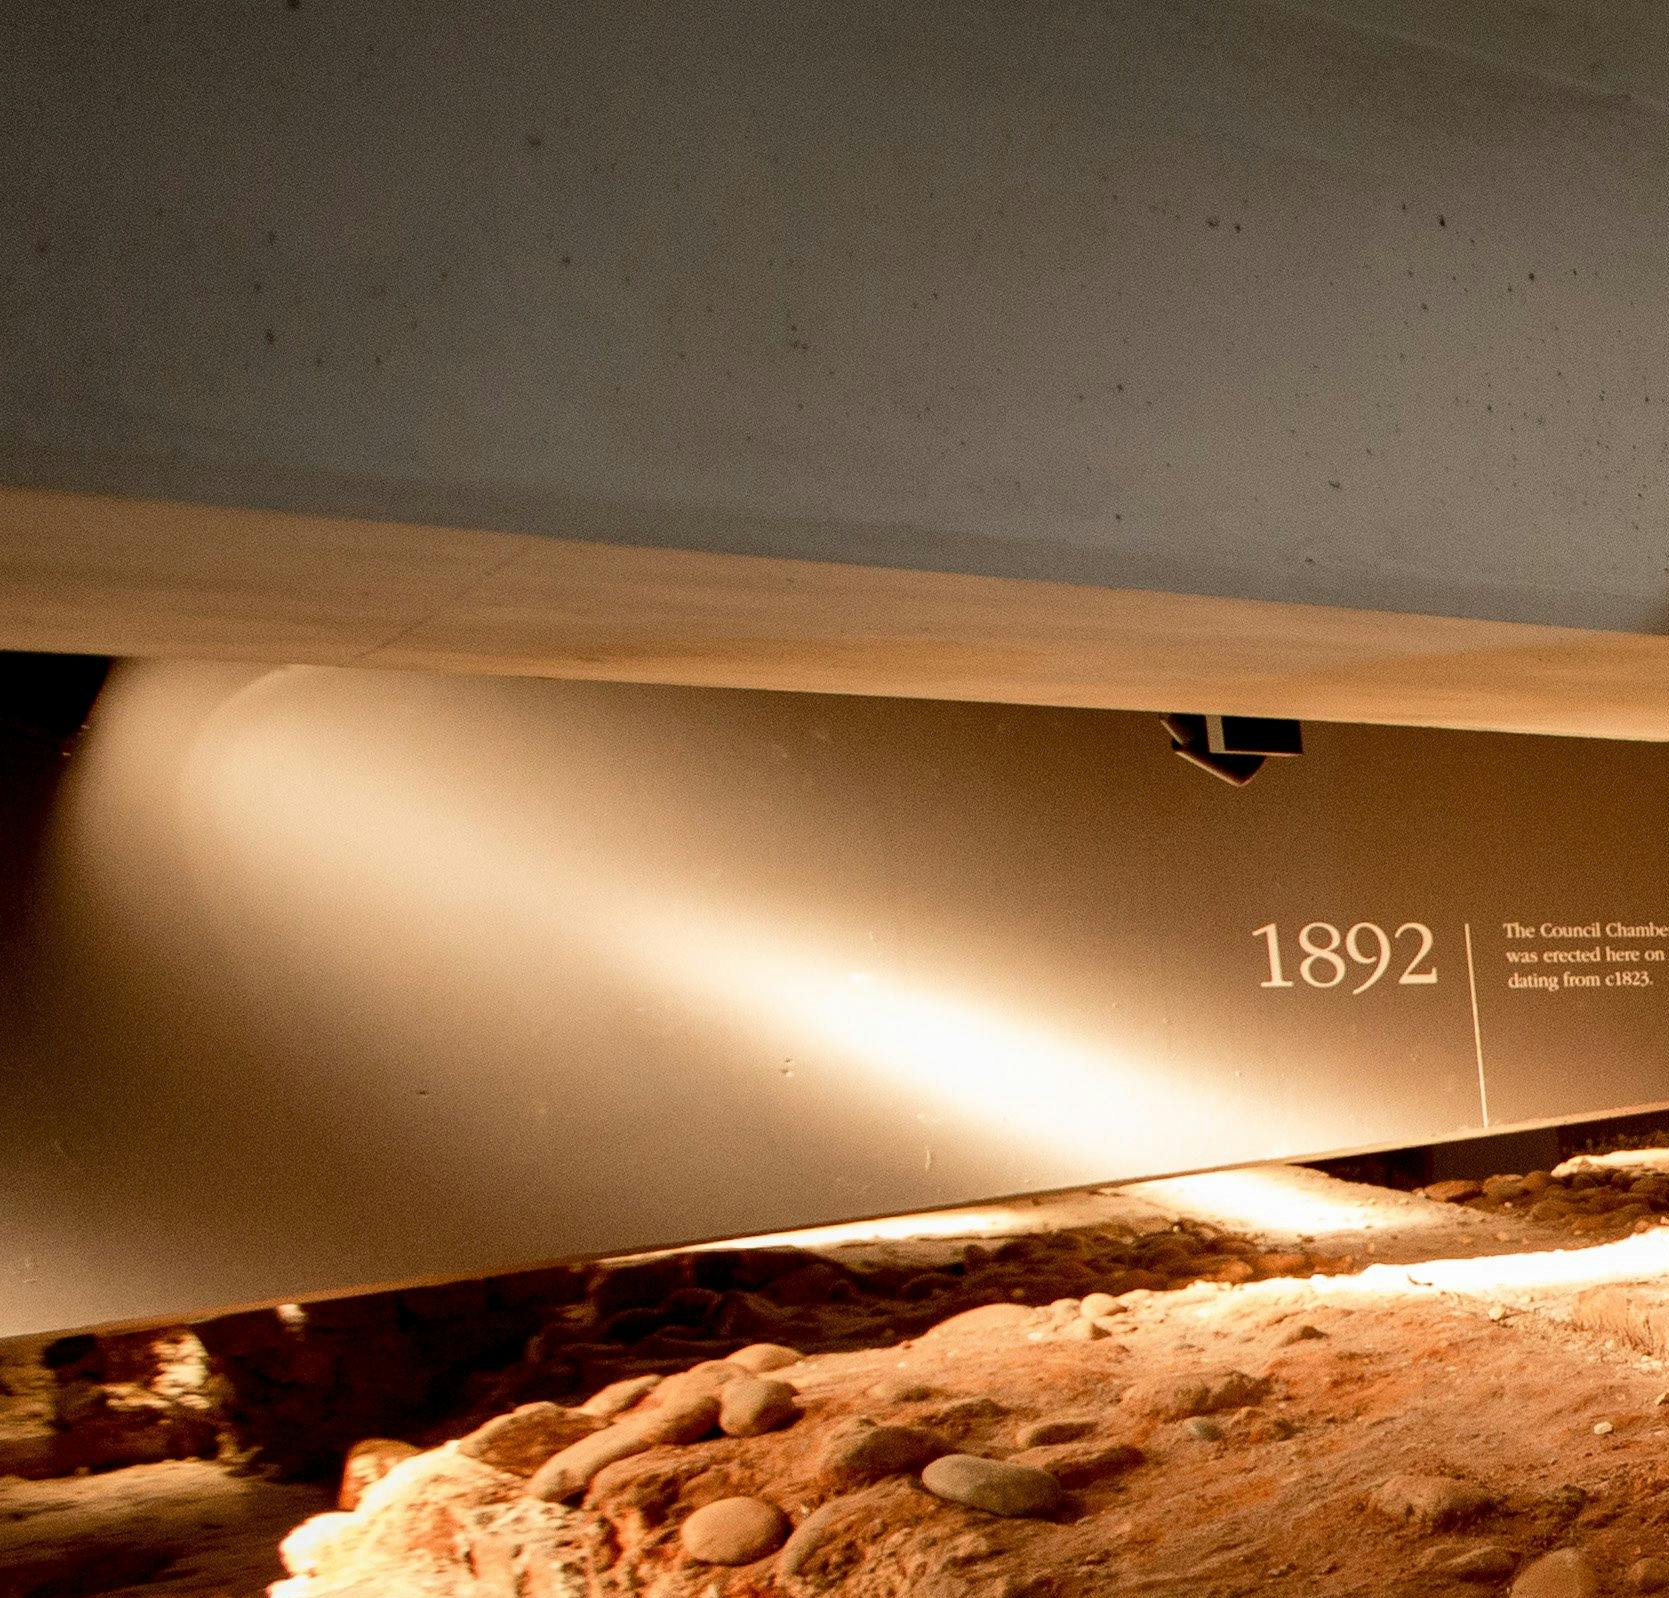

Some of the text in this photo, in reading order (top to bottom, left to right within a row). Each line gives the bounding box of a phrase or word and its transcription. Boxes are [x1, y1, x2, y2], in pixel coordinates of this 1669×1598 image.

[1503, 922, 1535, 938] The
[1540, 923, 1600, 938] Council
[1252, 922, 1438, 995] 1892
[1506, 949, 1537, 963] was
[1543, 946, 1600, 963] erected
[1605, 946, 1640, 962] here
[1644, 949, 1665, 962] on
[1508, 970, 1653, 991] dating from c1823.
